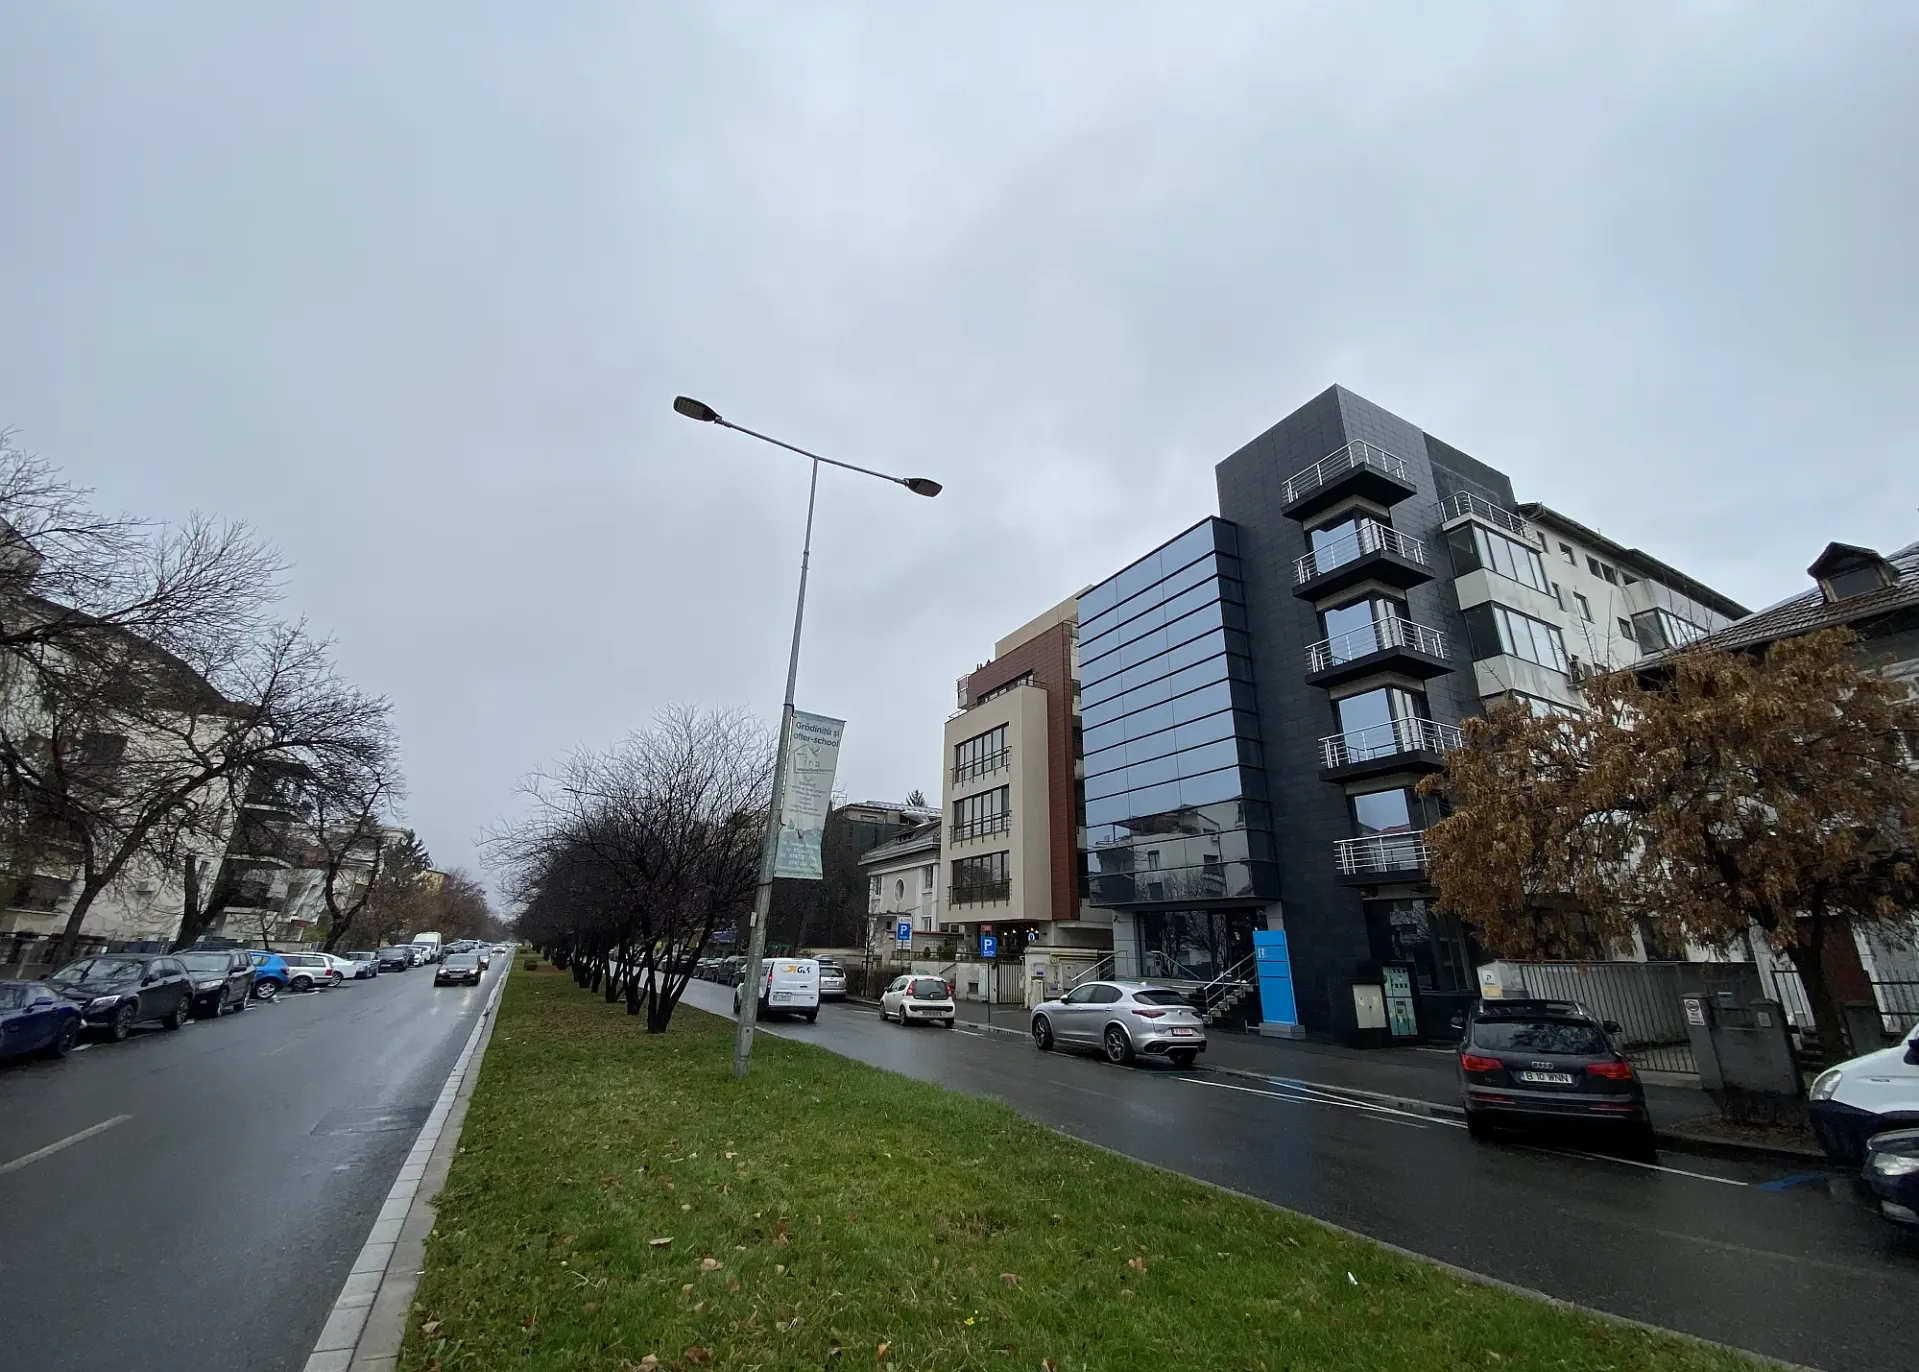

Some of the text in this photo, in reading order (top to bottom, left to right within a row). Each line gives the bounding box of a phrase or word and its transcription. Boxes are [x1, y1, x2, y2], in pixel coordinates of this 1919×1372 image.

[794, 732, 840, 748] after-school
[900, 925, 908, 935] P
[984, 939, 993, 951] P
[1526, 1072, 1569, 1082] B 10 WNN
